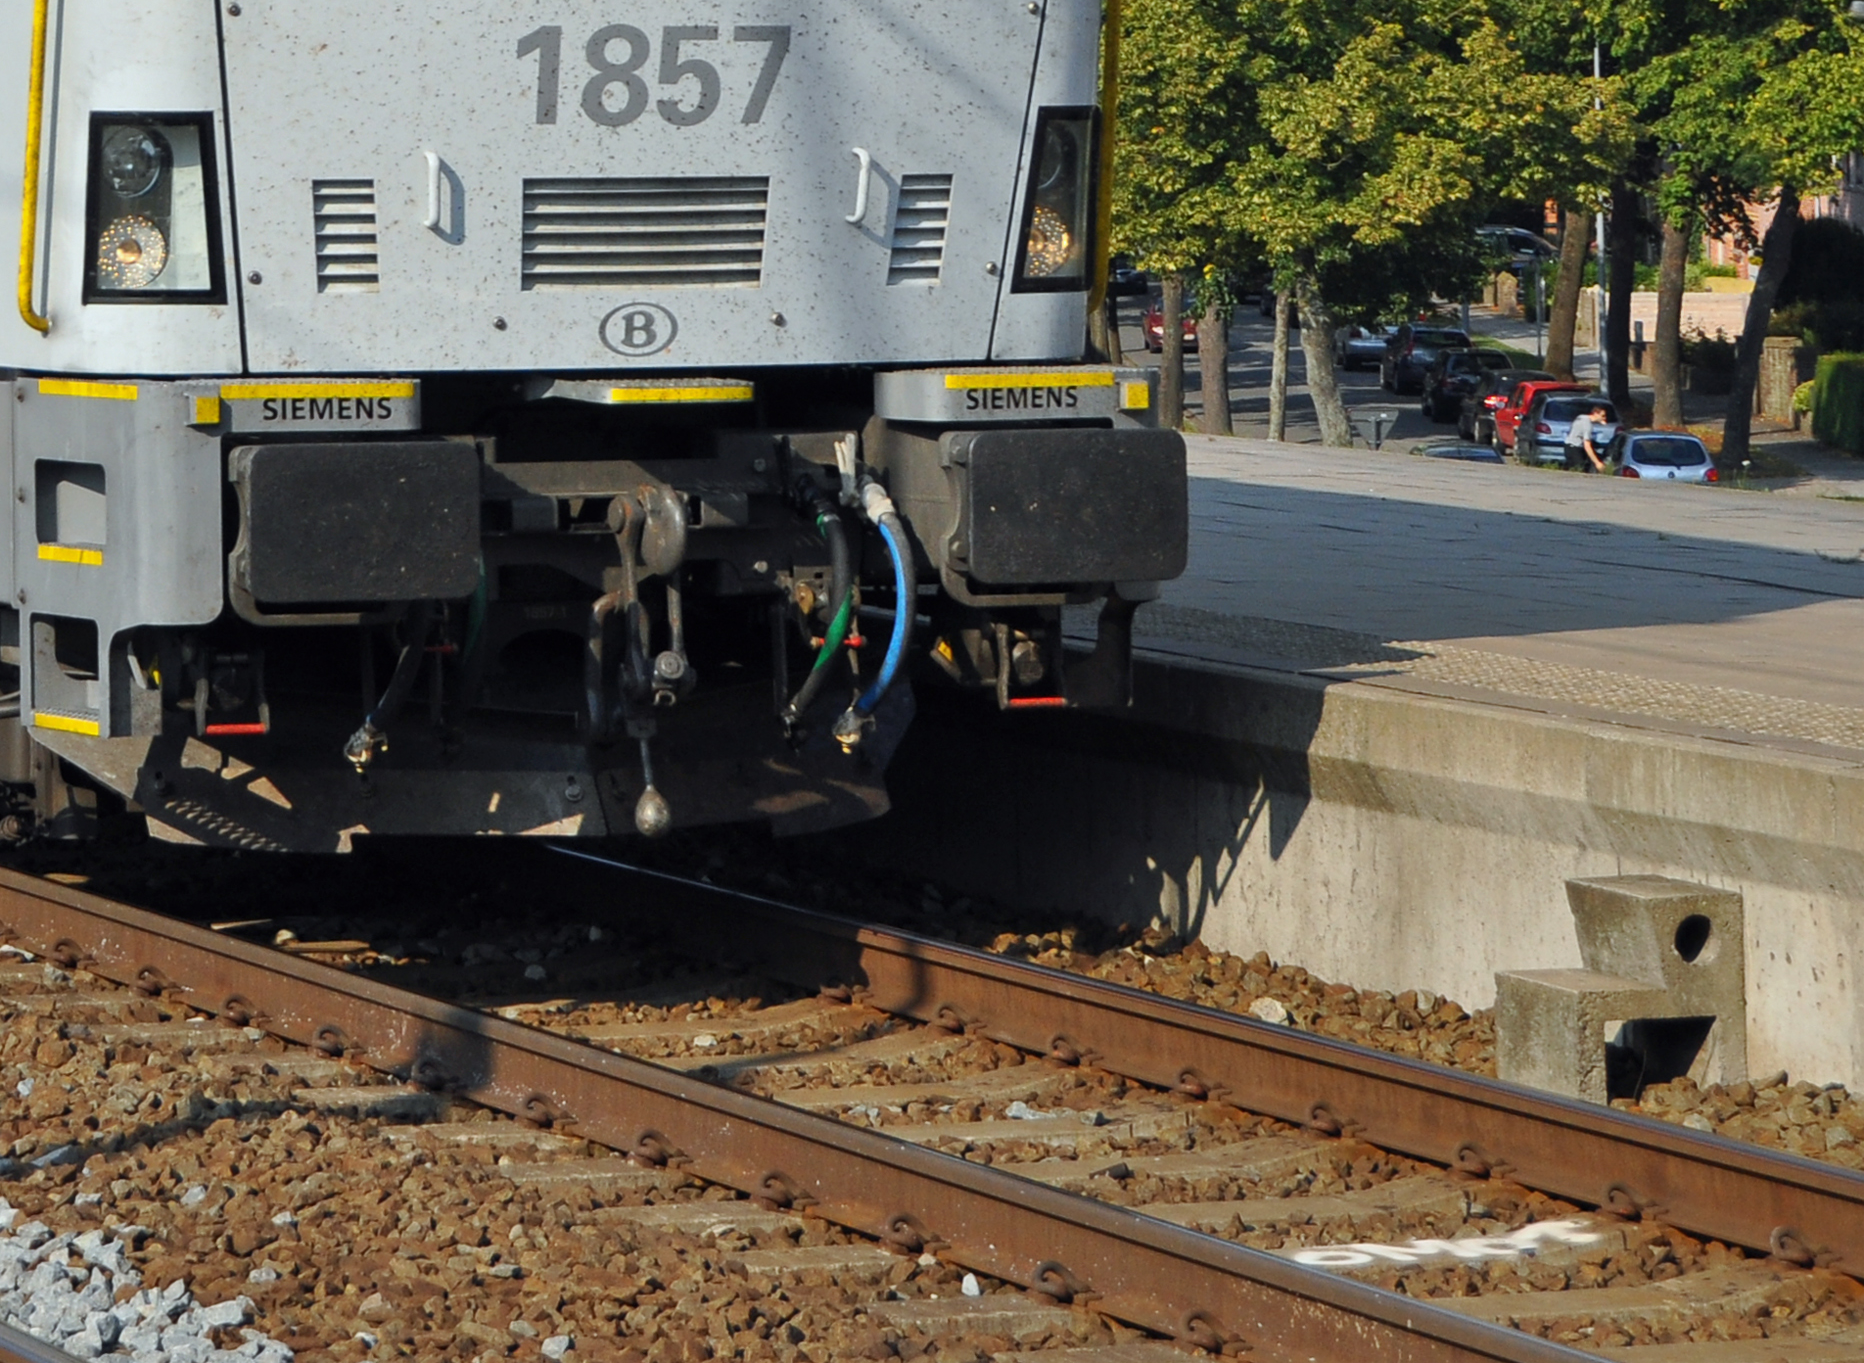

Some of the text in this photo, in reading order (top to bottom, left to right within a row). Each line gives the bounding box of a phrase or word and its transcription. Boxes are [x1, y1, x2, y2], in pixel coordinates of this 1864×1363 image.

[516, 23, 792, 127] 1857
[262, 397, 393, 421] SIEMENS
[965, 385, 1079, 410] SIEMENS
